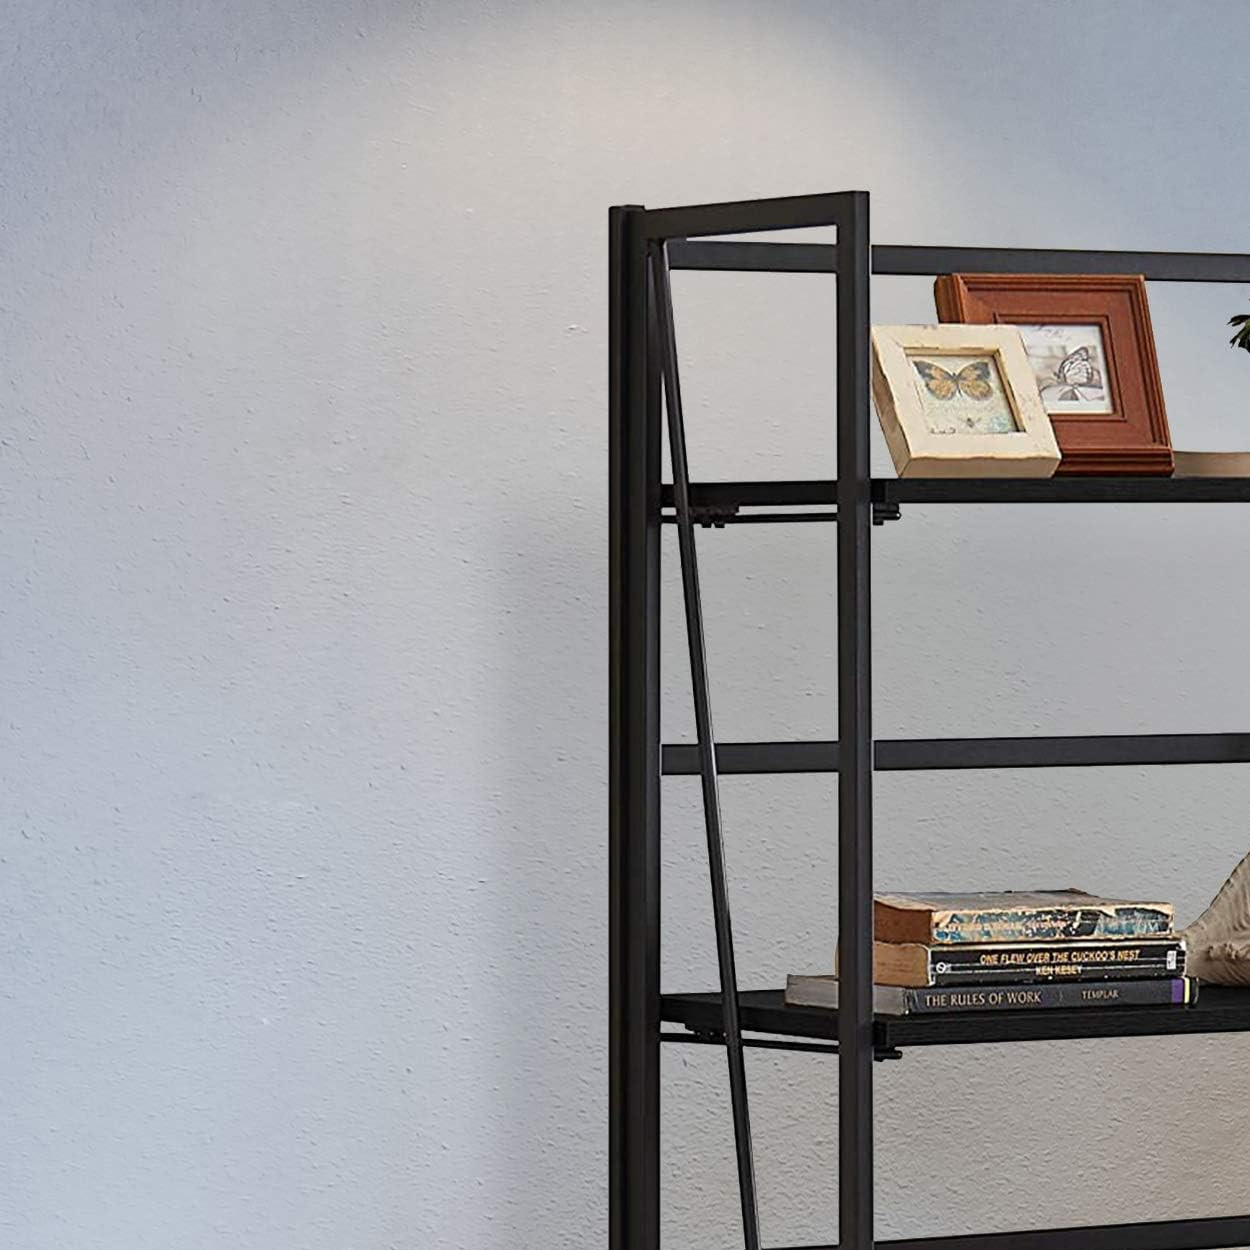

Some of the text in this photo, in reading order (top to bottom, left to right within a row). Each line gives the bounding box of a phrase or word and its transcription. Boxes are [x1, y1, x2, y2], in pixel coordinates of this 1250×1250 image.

[980, 949, 1141, 965] ONE FLEW OVER THE CUCKOO'S NEST
[1036, 965, 1053, 975] KEN
[926, 991, 1042, 1007] THE RULES OF WORK
[1082, 990, 1119, 1000] TEMPLAR
